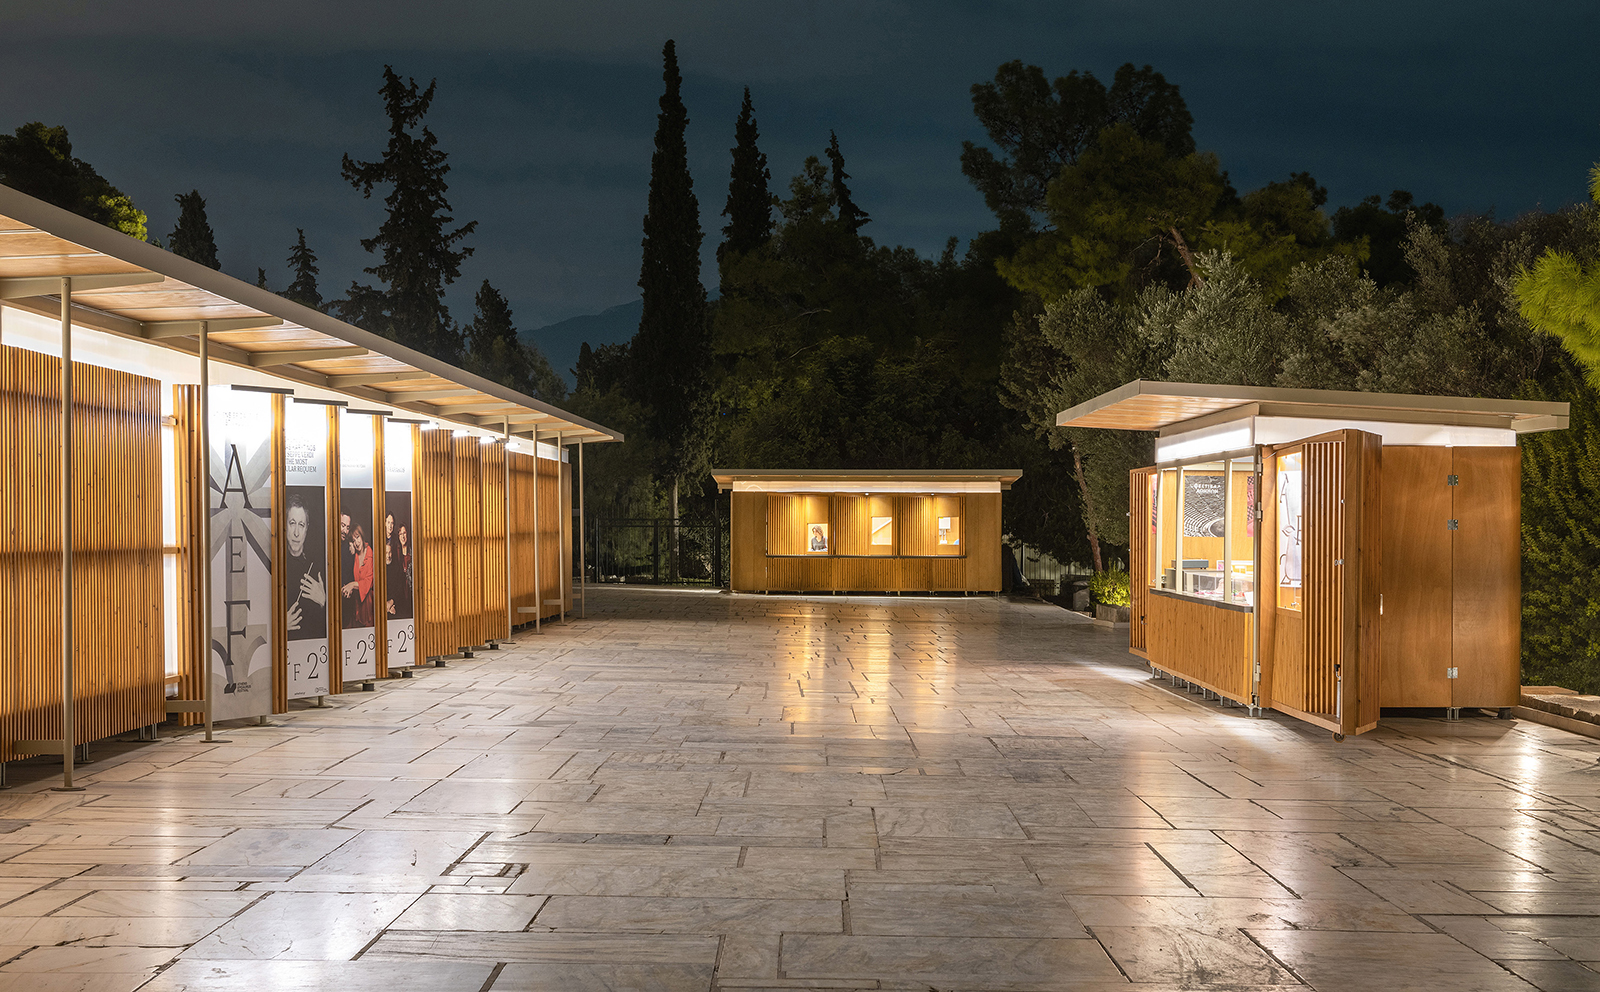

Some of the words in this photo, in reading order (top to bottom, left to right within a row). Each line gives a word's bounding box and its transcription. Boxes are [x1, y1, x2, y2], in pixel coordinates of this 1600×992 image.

[297, 466, 317, 474] REQUIEM
[345, 650, 351, 666] F
[294, 663, 301, 681] F
